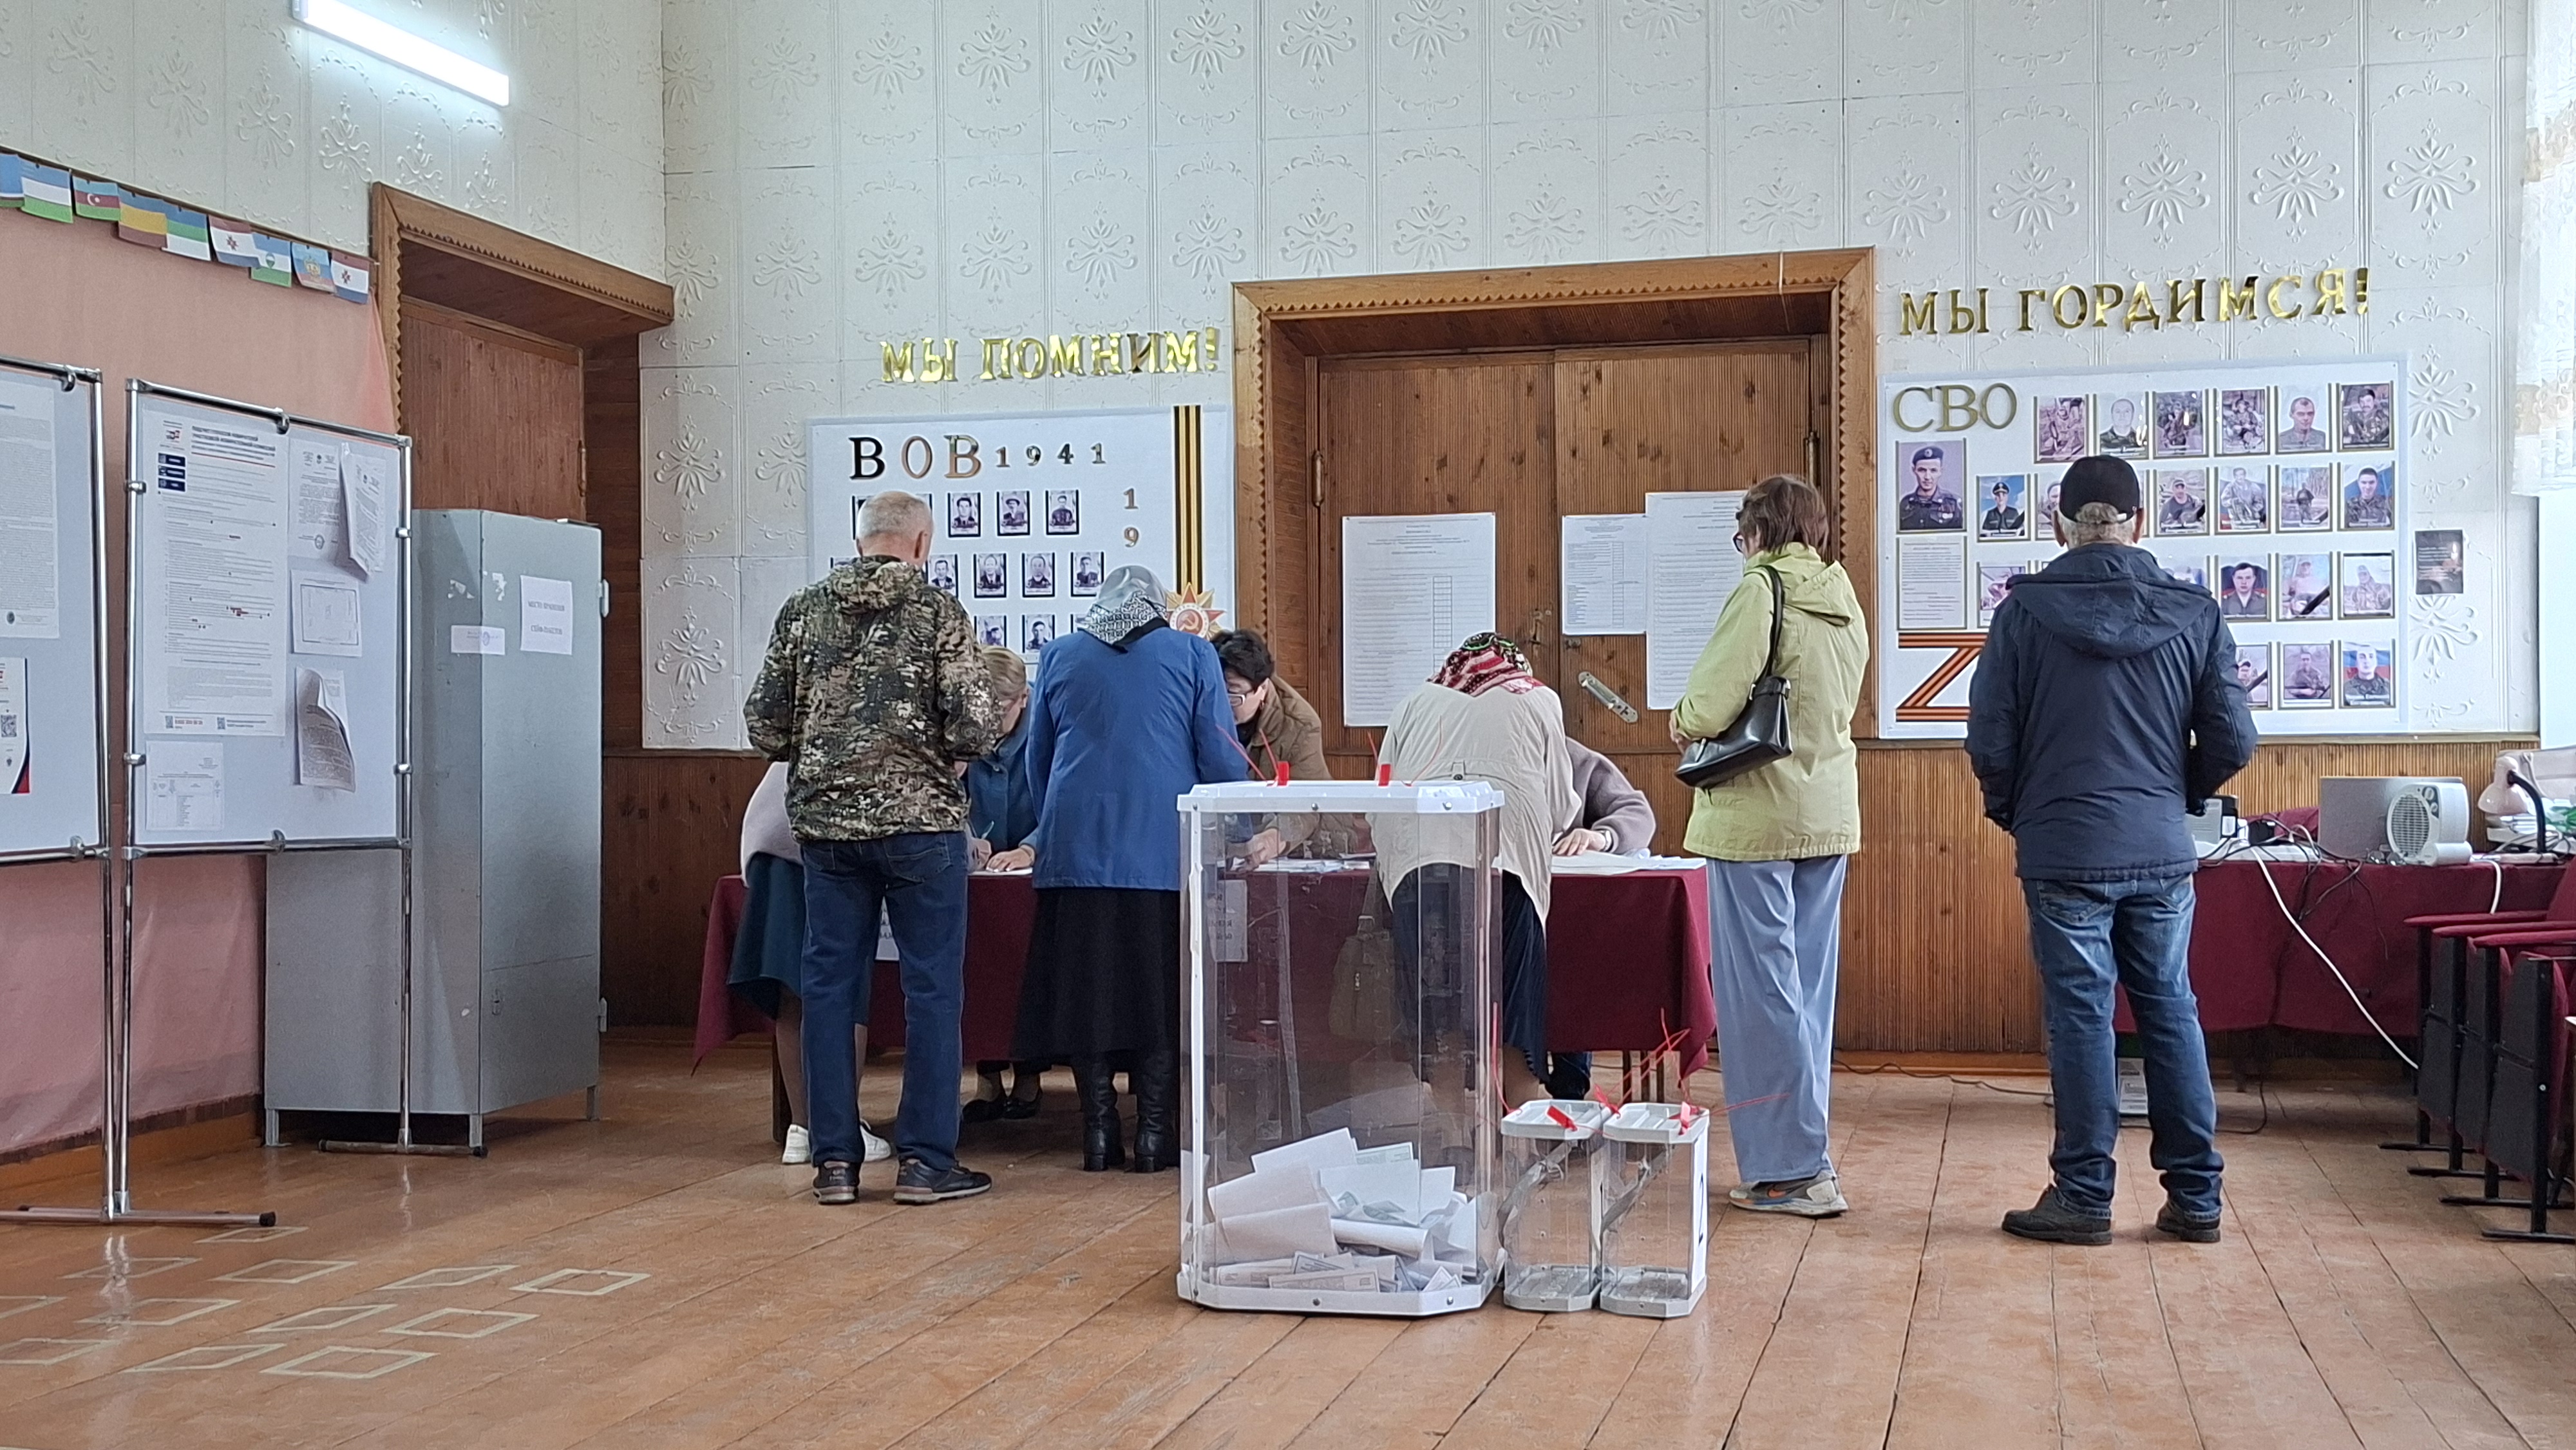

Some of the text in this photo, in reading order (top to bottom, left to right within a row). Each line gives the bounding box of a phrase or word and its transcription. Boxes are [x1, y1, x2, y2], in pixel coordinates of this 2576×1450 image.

[1899, 267, 2369, 335] МЫ ГОРДИМСЯ!
[880, 326, 1220, 382] МЫ ПОМНИМ!
[1893, 382, 2017, 433] СВО
[849, 435, 1106, 480] ВОВ 1941
